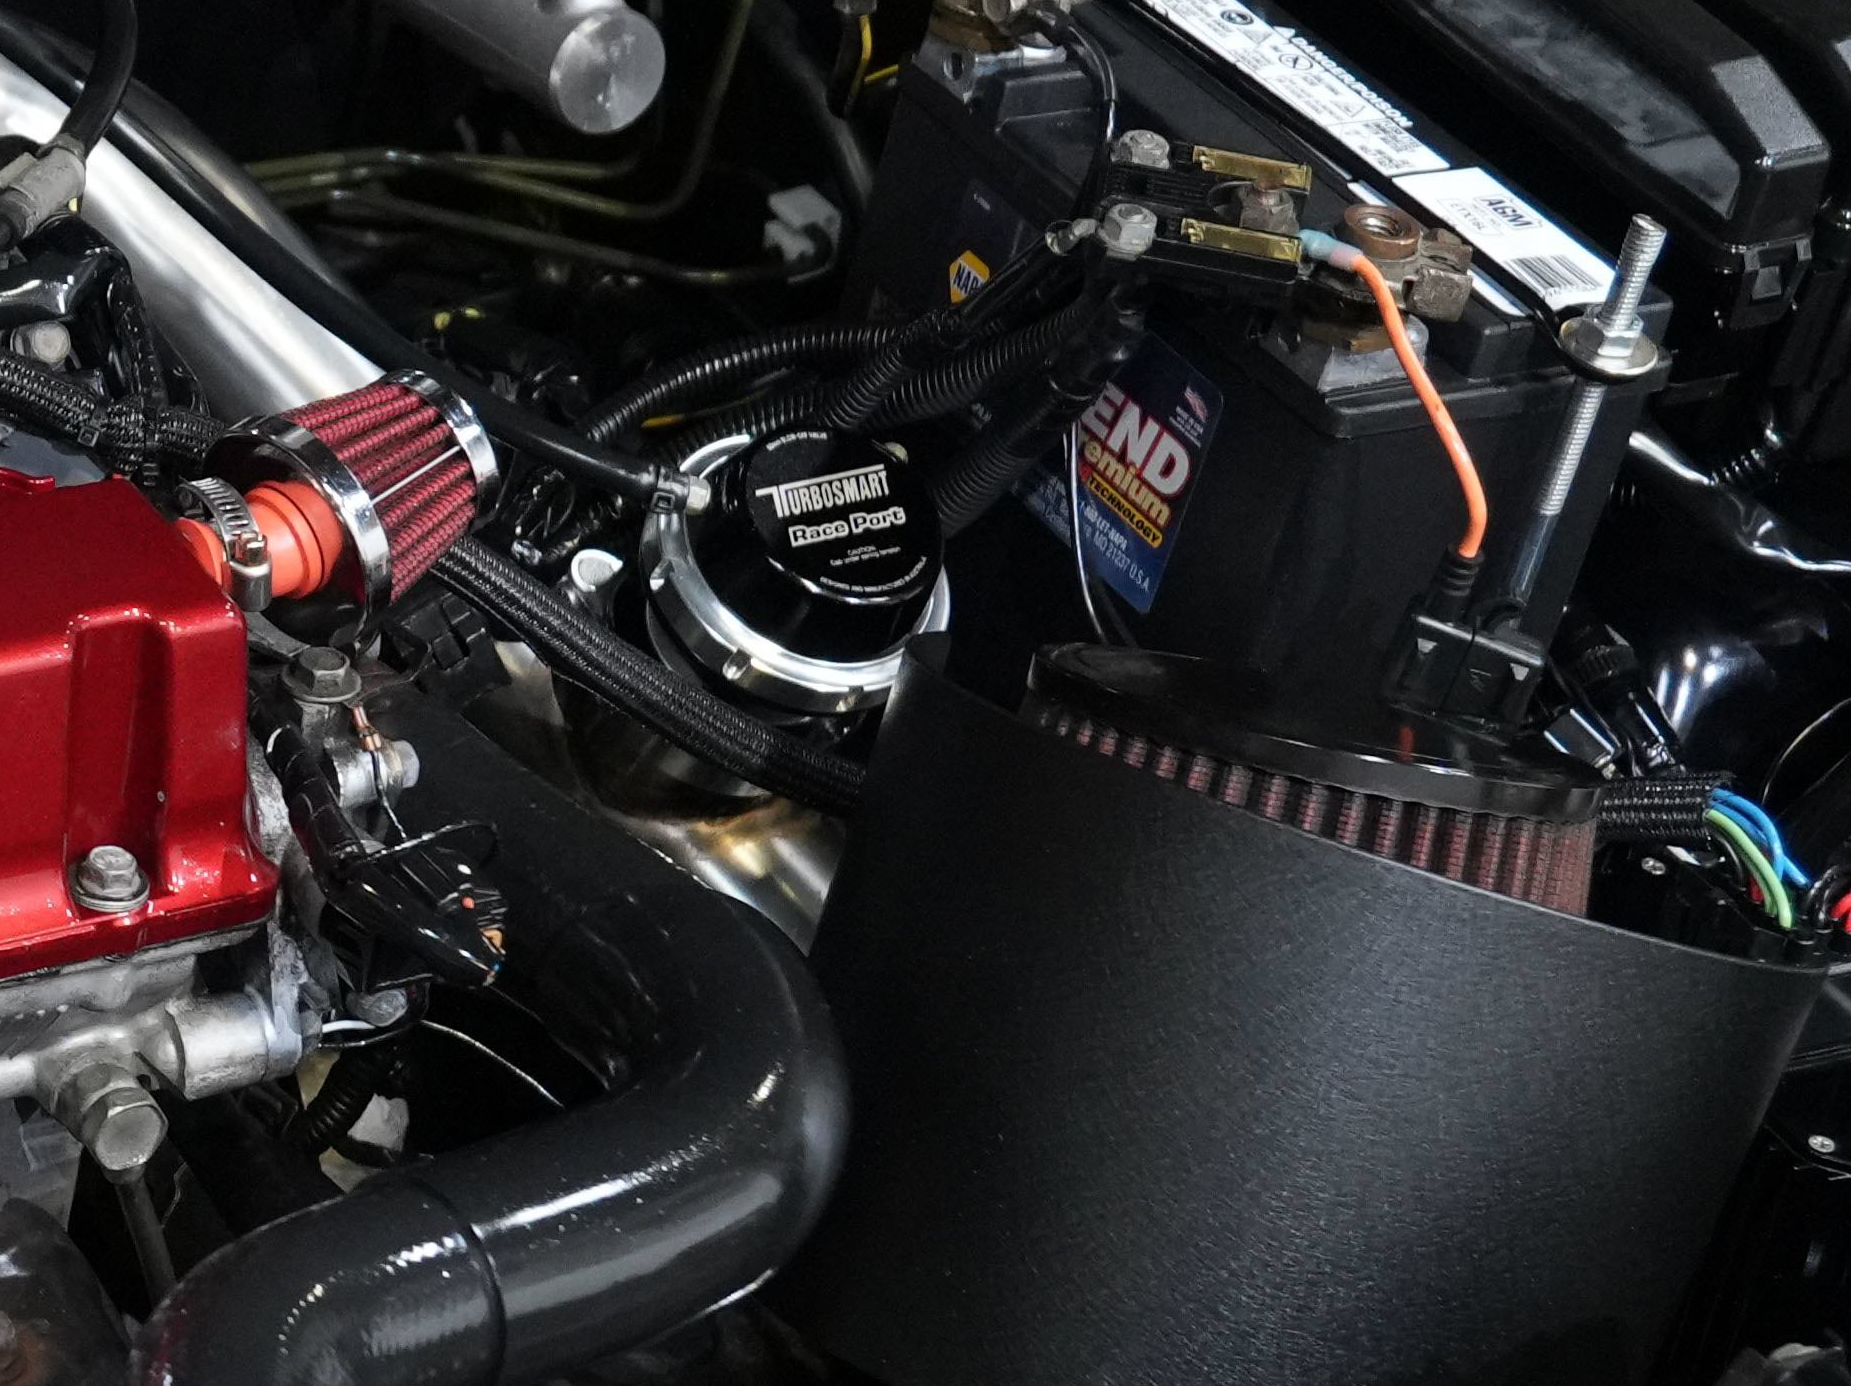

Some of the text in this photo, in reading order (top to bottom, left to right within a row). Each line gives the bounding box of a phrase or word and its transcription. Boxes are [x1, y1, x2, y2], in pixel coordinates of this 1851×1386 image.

[1481, 197, 1533, 228] AGM
[755, 463, 891, 519] TURBOSMART
[1088, 475, 1160, 544] TECHNOLOGY
[788, 506, 907, 548] Race Port
